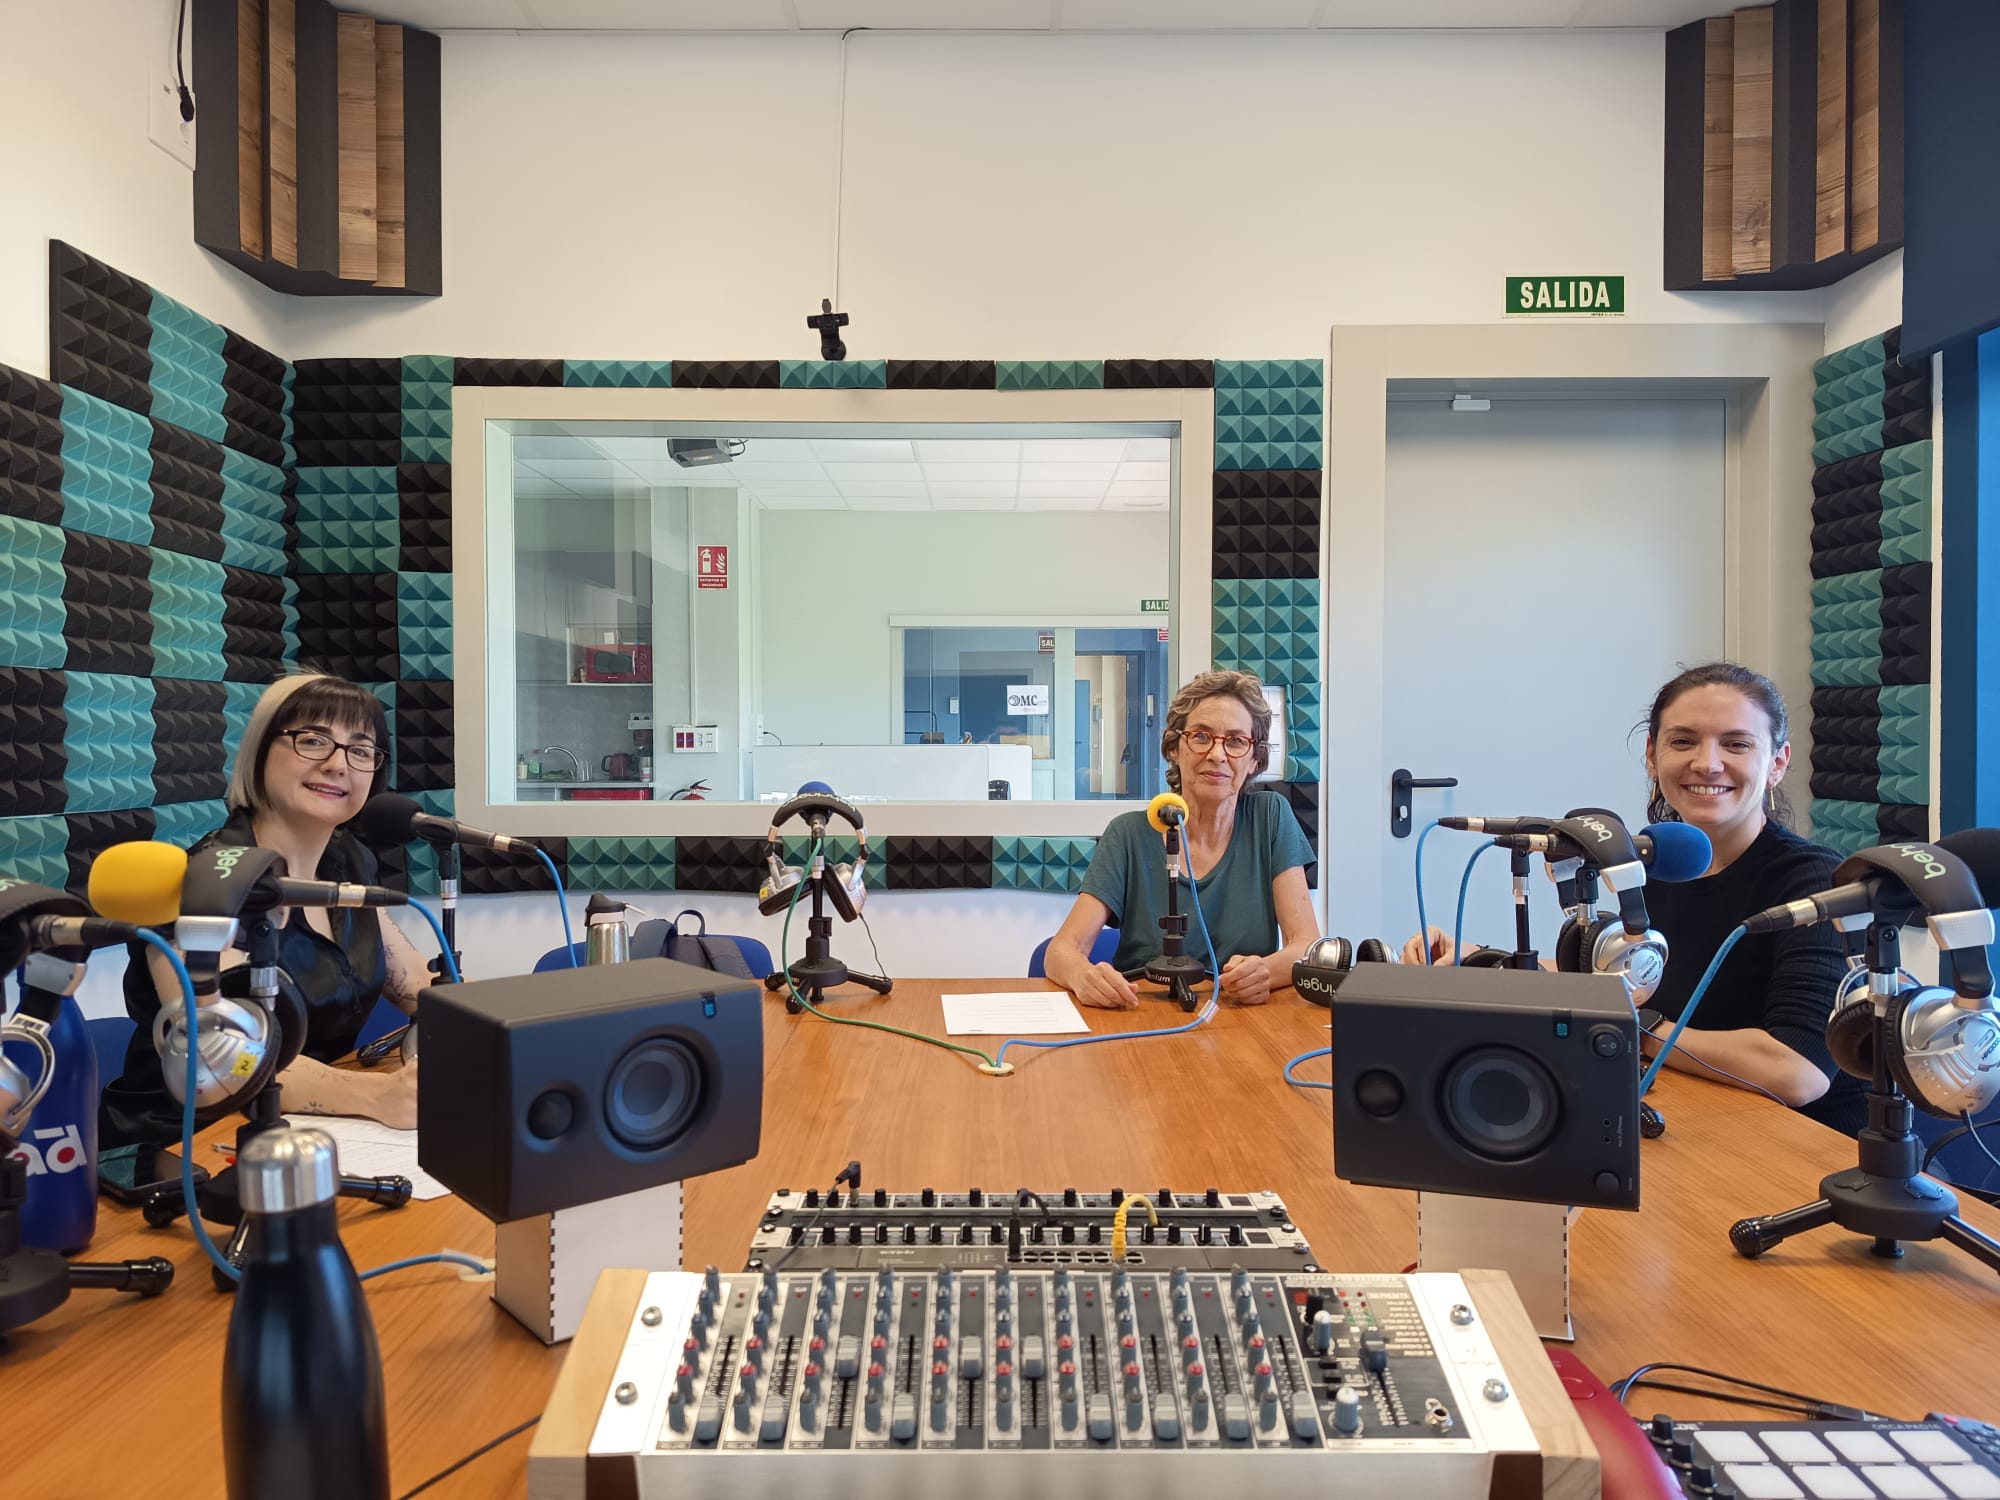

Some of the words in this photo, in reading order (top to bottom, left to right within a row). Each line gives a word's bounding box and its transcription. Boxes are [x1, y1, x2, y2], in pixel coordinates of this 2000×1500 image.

[1520, 281, 1610, 309] SALIDA
[1296, 977, 1336, 997] inger
[240, 1060, 249, 1071] 2
